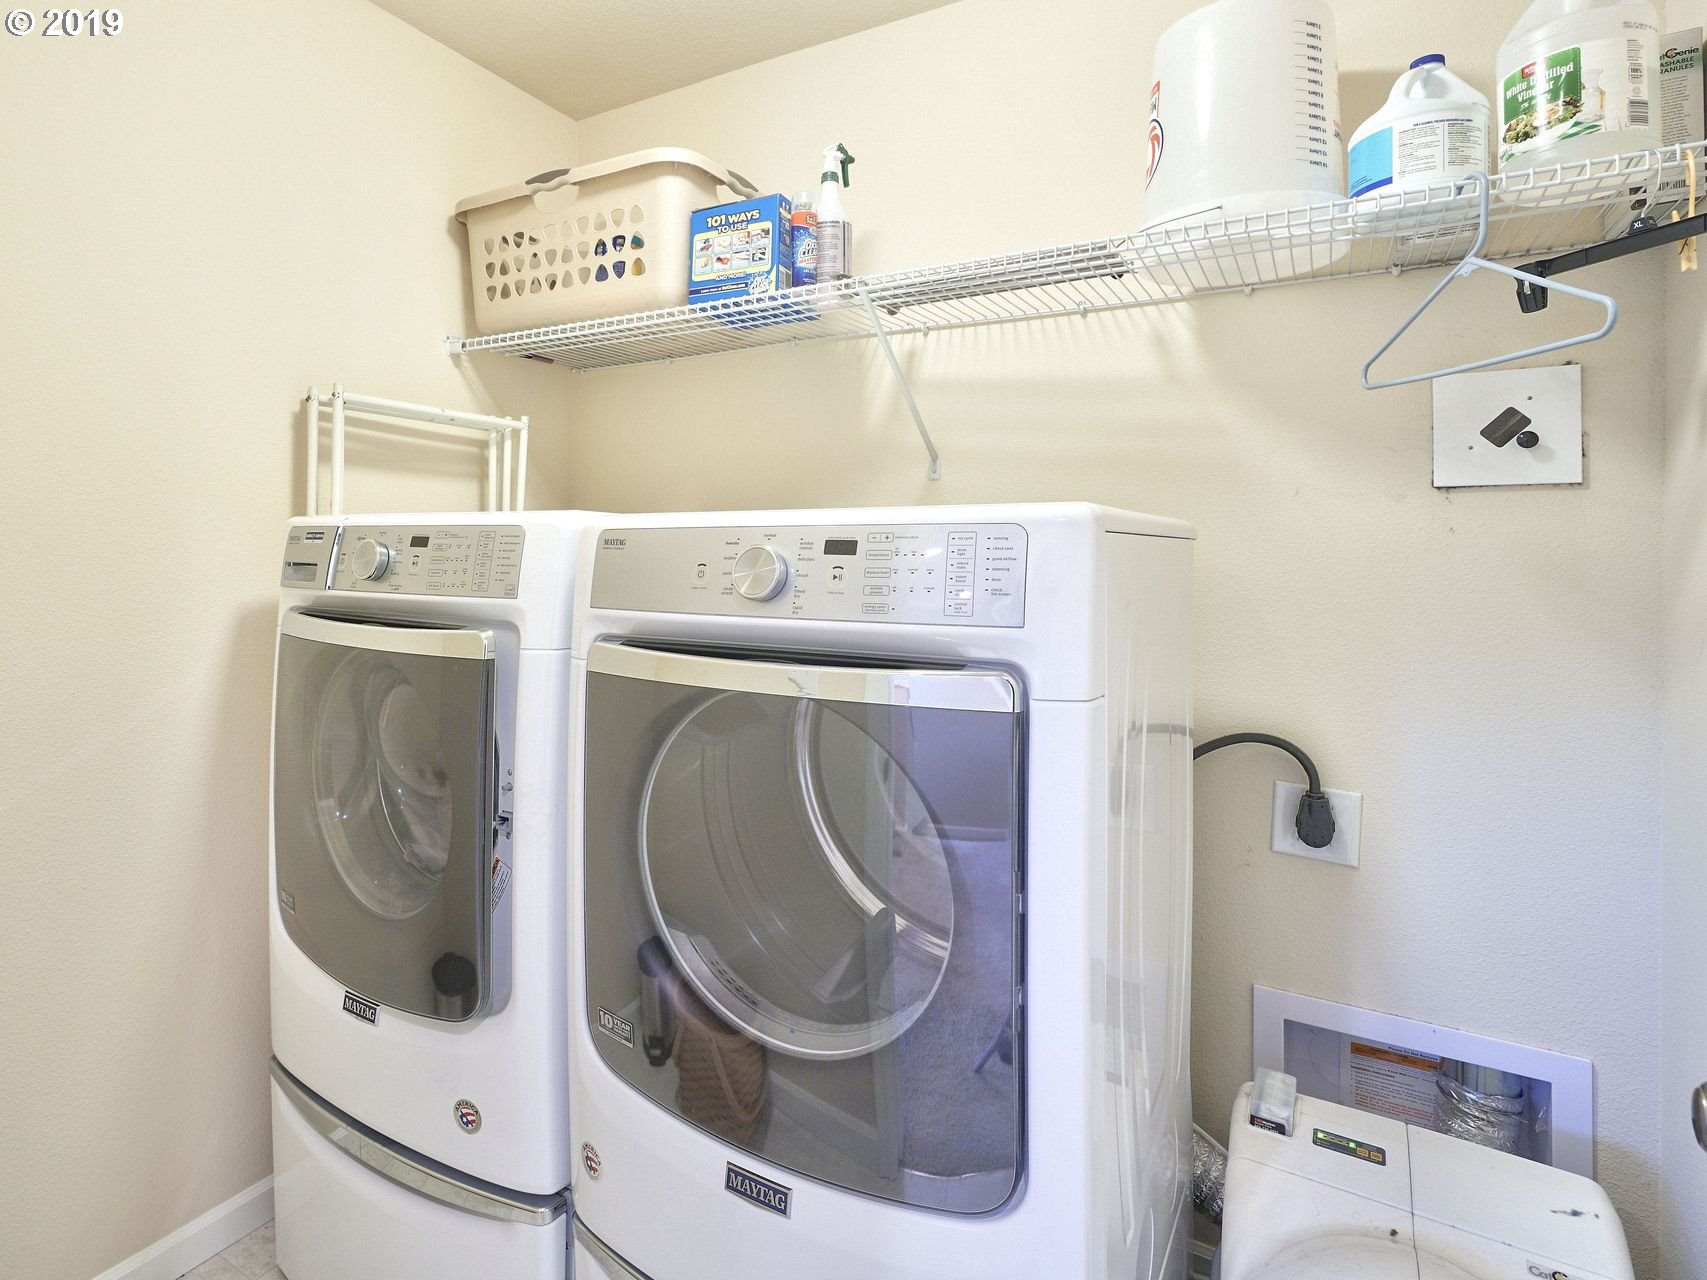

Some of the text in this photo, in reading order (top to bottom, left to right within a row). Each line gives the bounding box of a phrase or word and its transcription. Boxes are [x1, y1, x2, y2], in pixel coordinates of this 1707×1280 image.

[1660, 56, 1694, 67] ASHABLE
[1660, 63, 1694, 74] RANULES
[1506, 82, 1527, 99] White
[1530, 62, 1574, 86] Dtilled
[1517, 80, 1554, 102] Viner
[707, 210, 760, 227] 101 WAYS
[1633, 220, 1643, 229] XL
[717, 222, 748, 234] TO USE
[344, 998, 376, 1020] MAYTAG
[600, 1011, 612, 1028] 10
[613, 1018, 630, 1031] YEAR
[456, 1101, 479, 1115] AMERICA
[728, 1173, 785, 1210] MAYTAG
